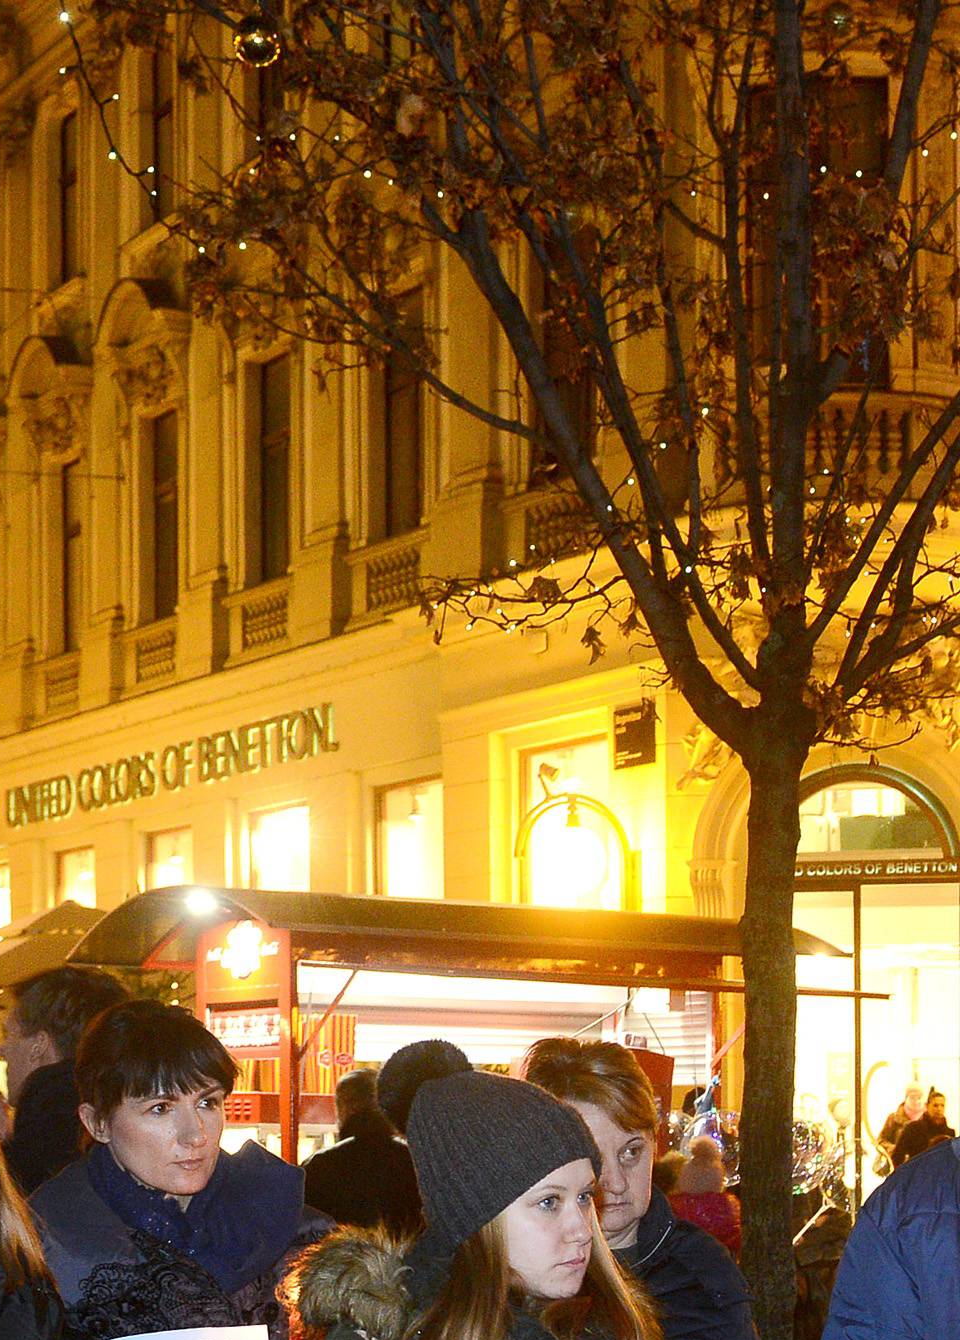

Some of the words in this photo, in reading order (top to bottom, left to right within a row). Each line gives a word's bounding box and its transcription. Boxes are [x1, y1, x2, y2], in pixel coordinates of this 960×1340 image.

[7, 775, 76, 828] UNITED
[78, 752, 158, 812] COLORS
[161, 741, 194, 791] OF
[807, 863, 861, 877] COLORS
[865, 862, 882, 875] OF
[886, 860, 958, 874] BENETTON
